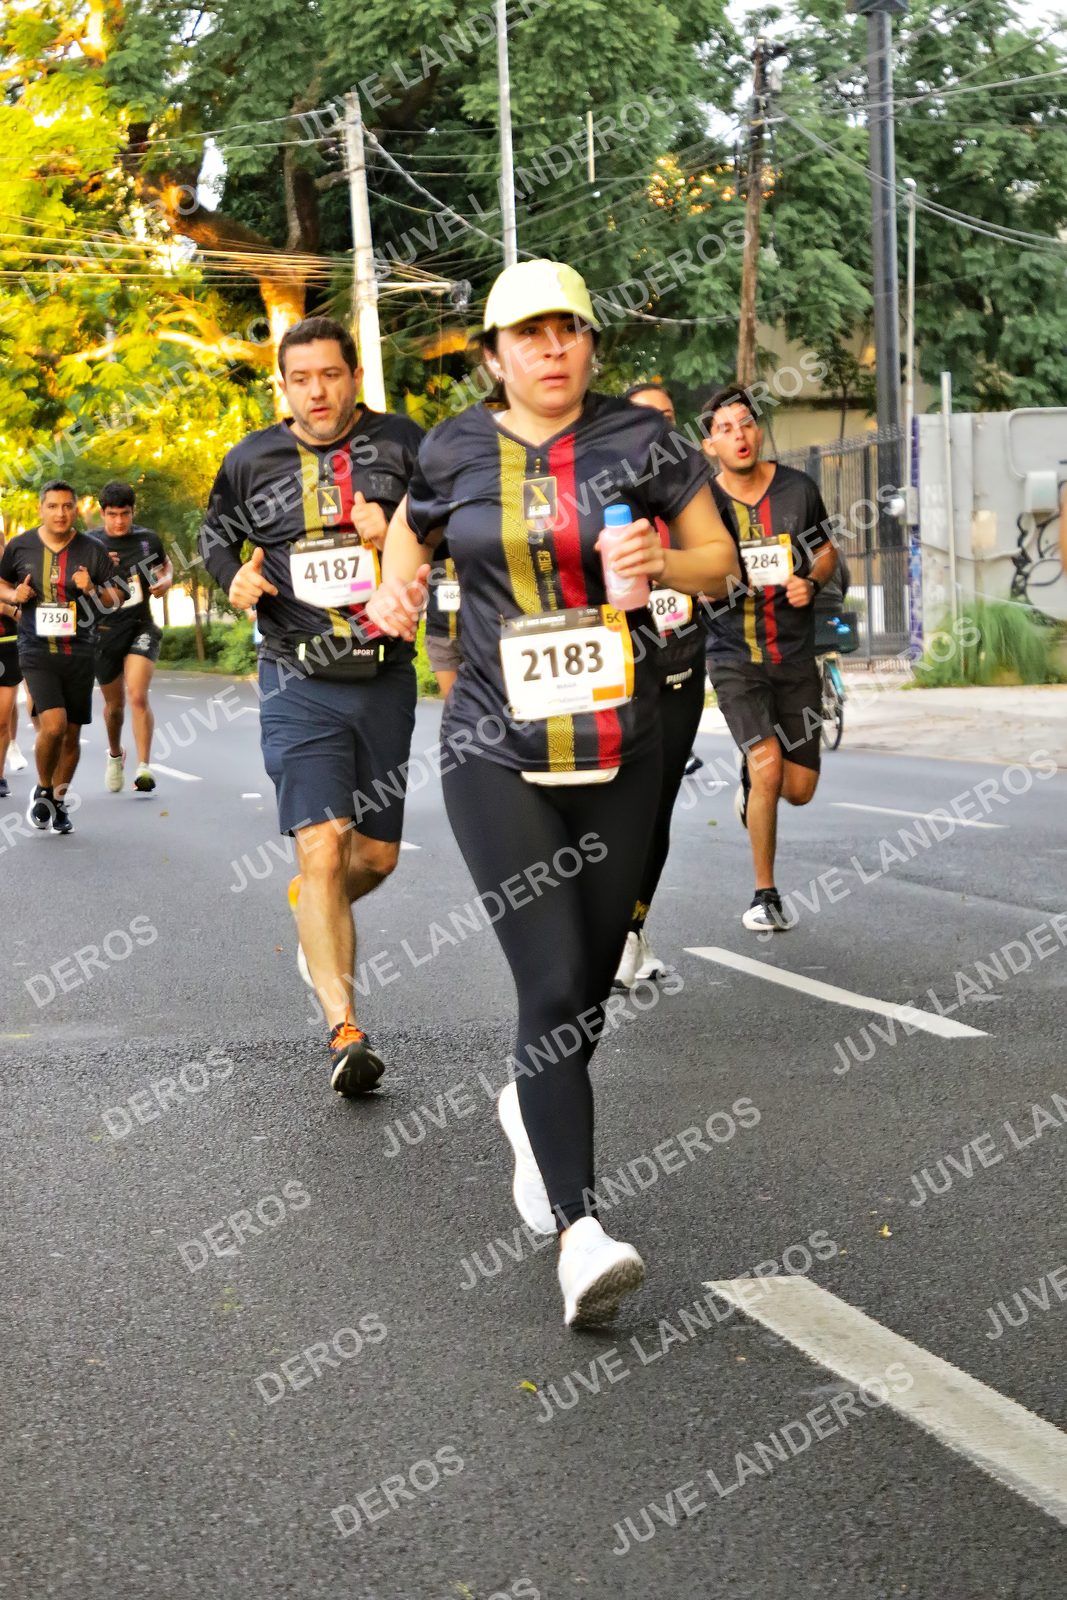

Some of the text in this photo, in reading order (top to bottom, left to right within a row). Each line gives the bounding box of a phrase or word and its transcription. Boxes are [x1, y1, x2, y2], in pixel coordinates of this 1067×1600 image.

[304, 555, 361, 583] 4187
[41, 612, 69, 623] 7350
[606, 612, 622, 624] 5K
[352, 649, 374, 657] SPORT
[521, 640, 604, 681] 2183
